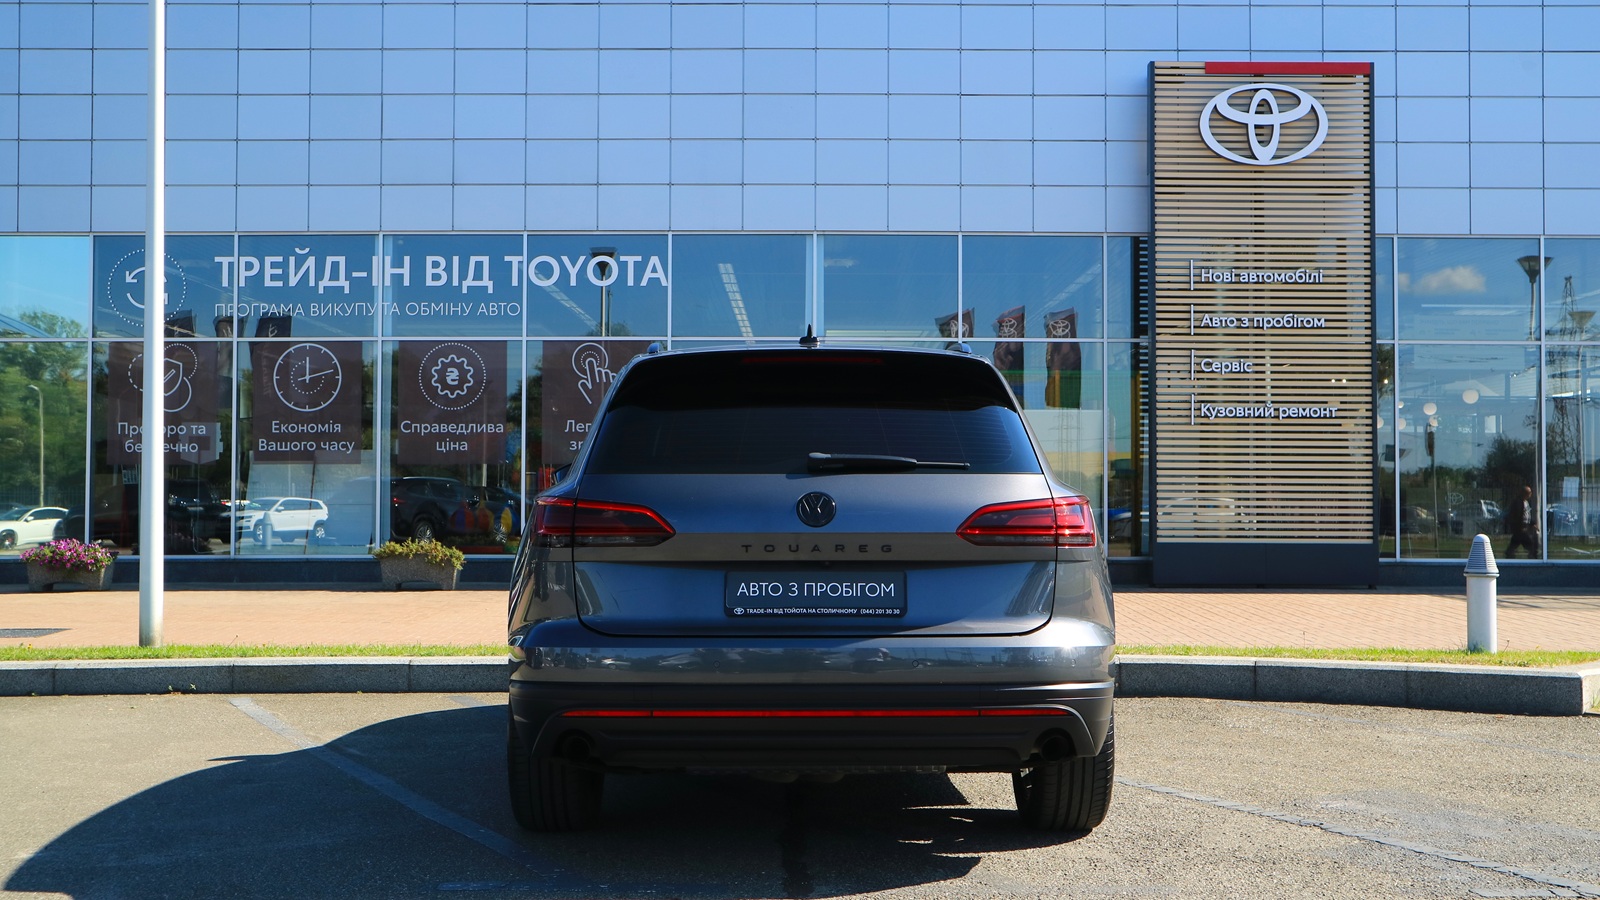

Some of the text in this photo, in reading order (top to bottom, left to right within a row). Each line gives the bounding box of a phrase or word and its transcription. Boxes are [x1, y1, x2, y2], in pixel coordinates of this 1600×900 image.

[214, 247, 668, 294] ТРЕЙД-ІН ВІД TOYOTA
[1201, 269, 1323, 283] Нові автомобілі
[214, 302, 521, 317] ПРОГРАМА ВИКУПУ ТА ОБМІНУ АВТО
[1201, 314, 1325, 330] Авто з пробігом
[1201, 359, 1253, 375] Сервіс
[1200, 403, 1337, 420] Кузовний ремонт
[117, 422, 206, 438] Прро та
[271, 420, 341, 434] Економія
[400, 420, 504, 436] Справедлива
[124, 439, 199, 453] беечно
[258, 438, 355, 454] Вашого часу
[436, 438, 468, 453] ціна
[741, 544, 893, 553] TOUAREG
[736, 582, 895, 597] АВТО З ПРОБІГОМ
